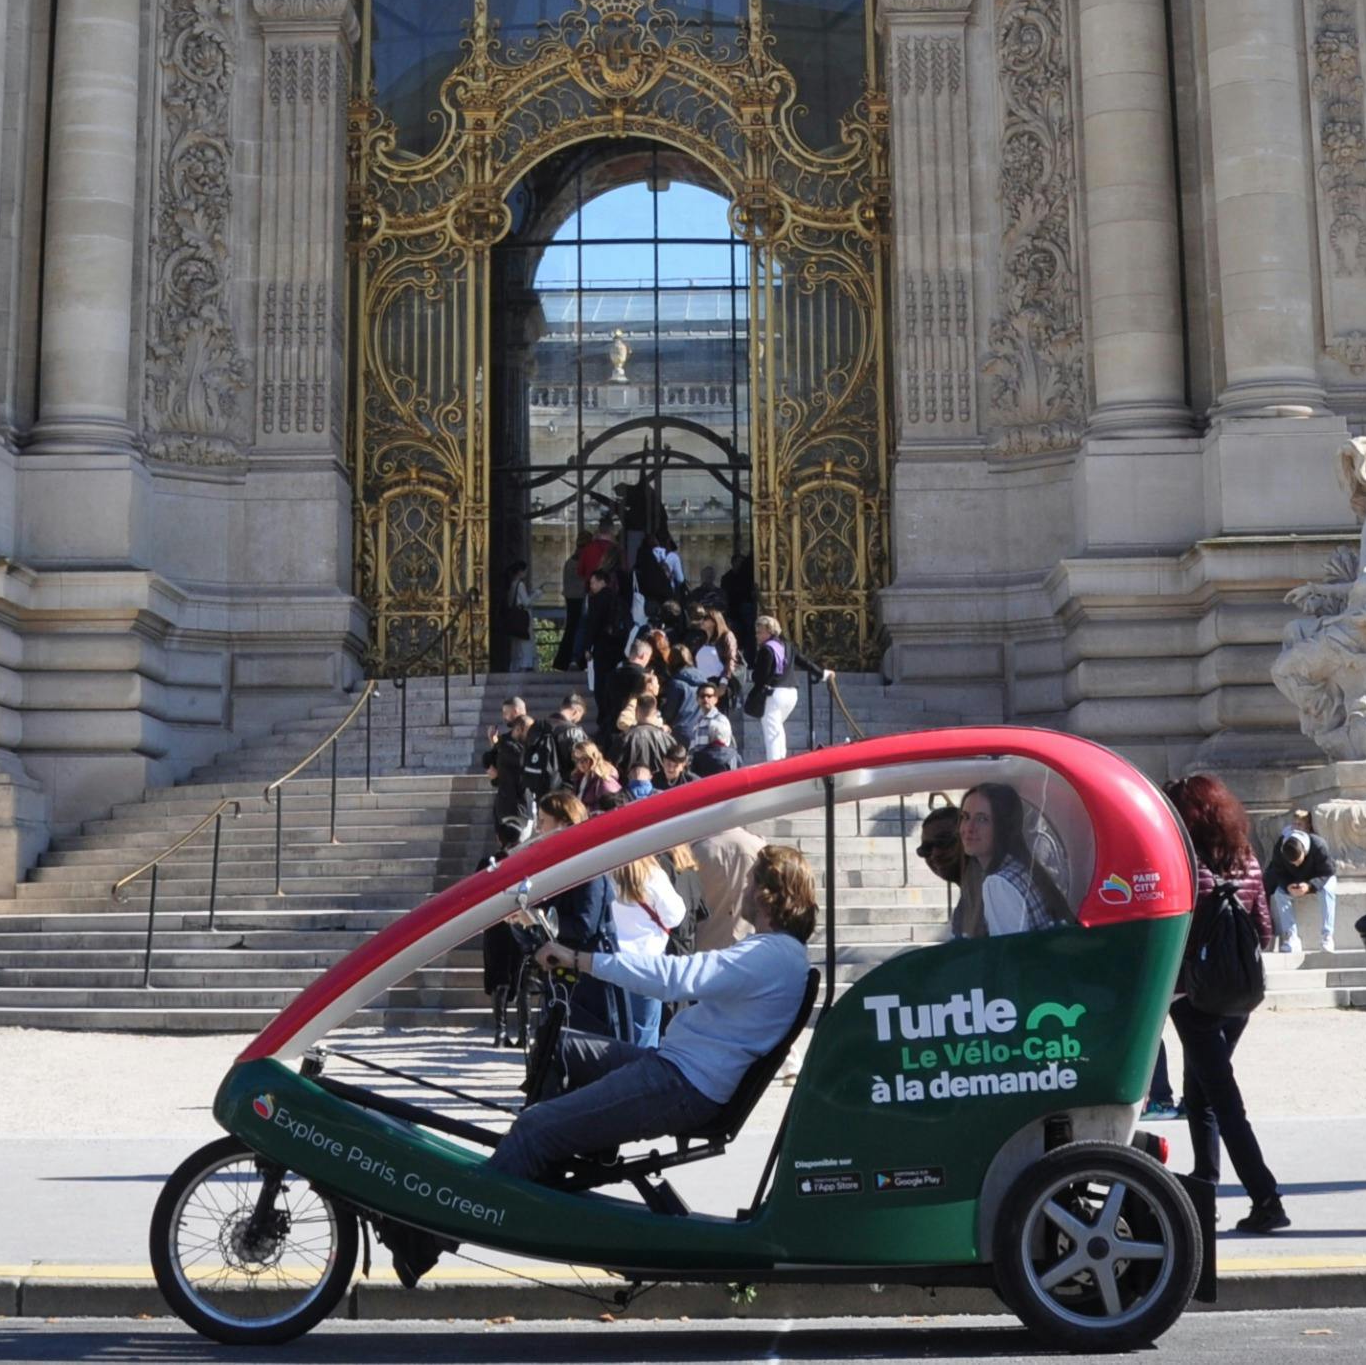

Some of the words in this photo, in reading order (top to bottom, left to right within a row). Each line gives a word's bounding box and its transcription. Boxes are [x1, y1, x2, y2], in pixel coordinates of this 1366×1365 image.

[1133, 872, 1161, 883] PARIS
[1134, 882, 1156, 892] CITY
[1135, 891, 1165, 901] VISION
[863, 988, 1018, 1042] Turtle
[902, 1046, 938, 1070] Le
[943, 1034, 1081, 1066] Vélo-Cab
[871, 1075, 891, 1104] à
[895, 1074, 925, 1102] la
[929, 1061, 1078, 1100] demande
[274, 1107, 344, 1157] Explore
[347, 1146, 397, 1186] Paris,
[403, 1172, 432, 1198] Go
[437, 1187, 506, 1226] Green!
[795, 1159, 837, 1169] Disponible
[836, 1180, 858, 1190] Store
[894, 1177, 923, 1187] Google
[924, 1175, 940, 1185] Play
